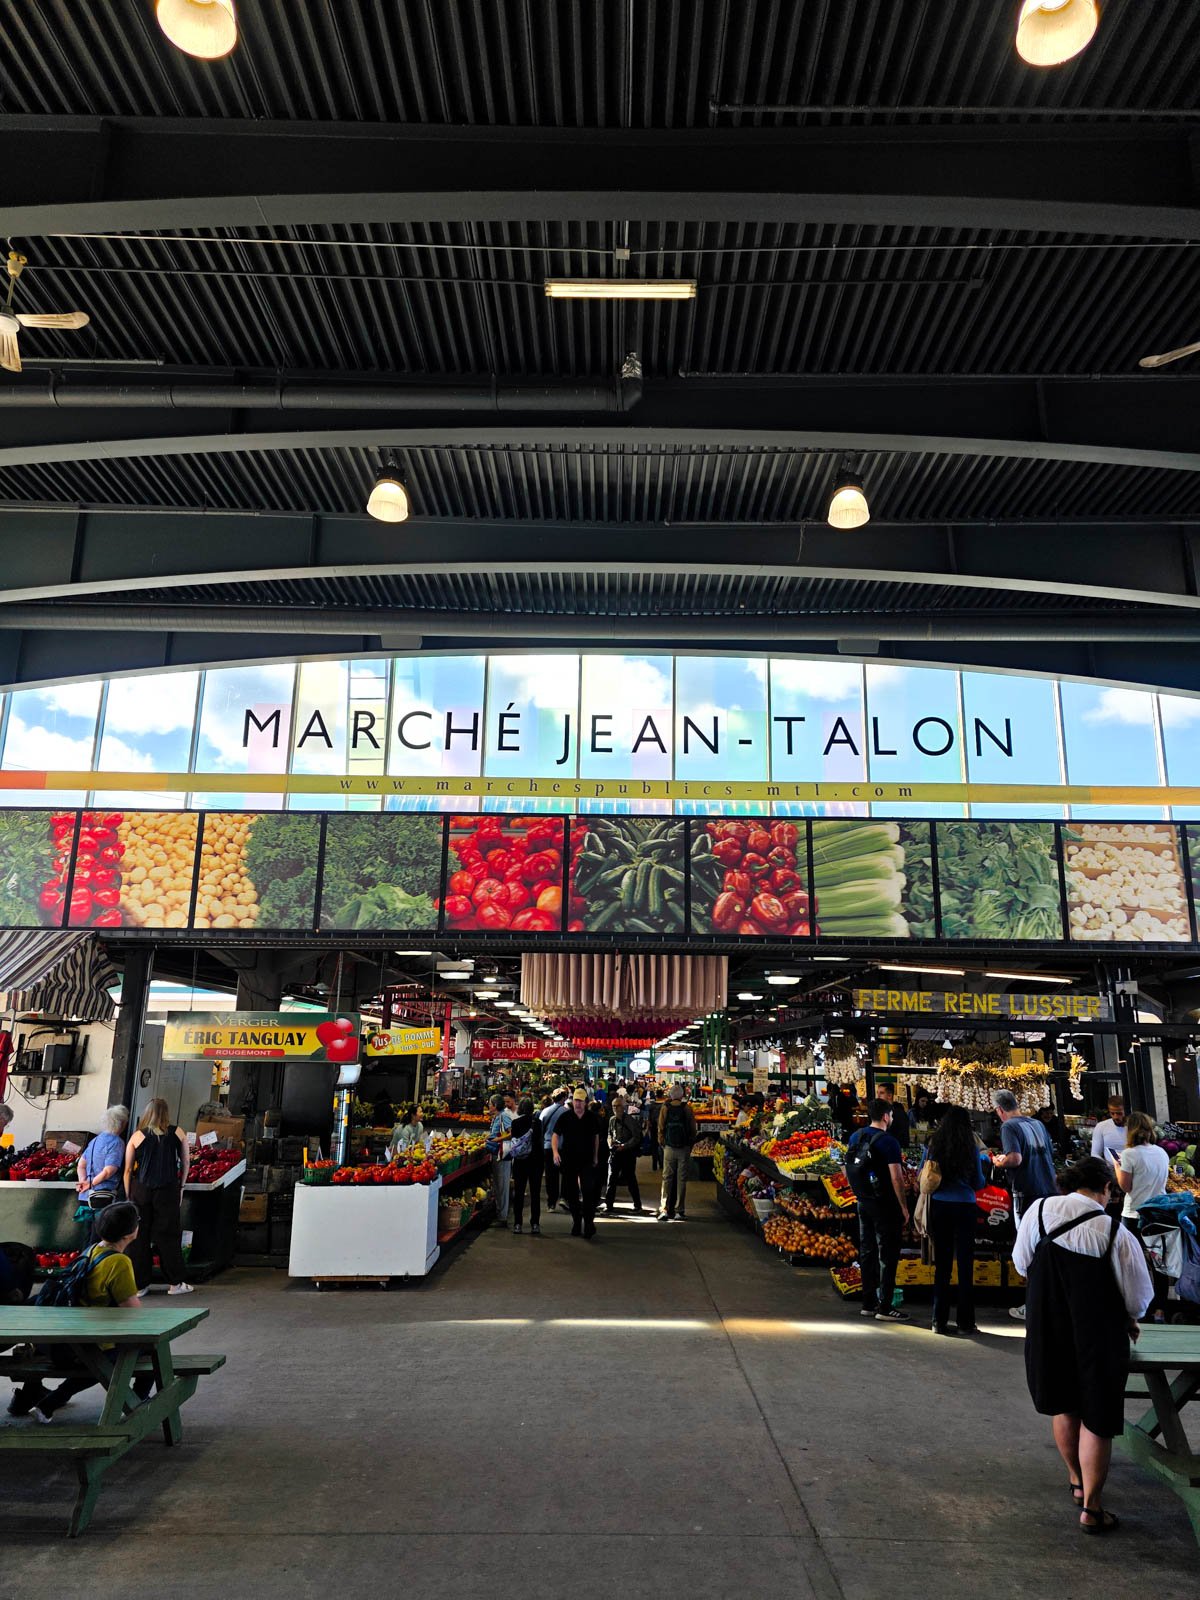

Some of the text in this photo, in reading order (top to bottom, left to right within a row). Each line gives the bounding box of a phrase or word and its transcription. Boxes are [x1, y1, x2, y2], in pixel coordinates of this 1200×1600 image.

[242, 703, 1014, 765] MARCHÉ JEAN-TALON
[340, 779, 913, 797] www.marchespublics-mtl.com
[857, 989, 1100, 1017] FERME RENE LUSSIER
[183, 1029, 307, 1046] ÉRIC TANGUAY
[374, 1029, 435, 1048] JUS DE POMME
[421, 1040, 435, 1049] PUR
[491, 1041, 537, 1049] FLEURISTE
[216, 1049, 272, 1057] ROUGEMONT
